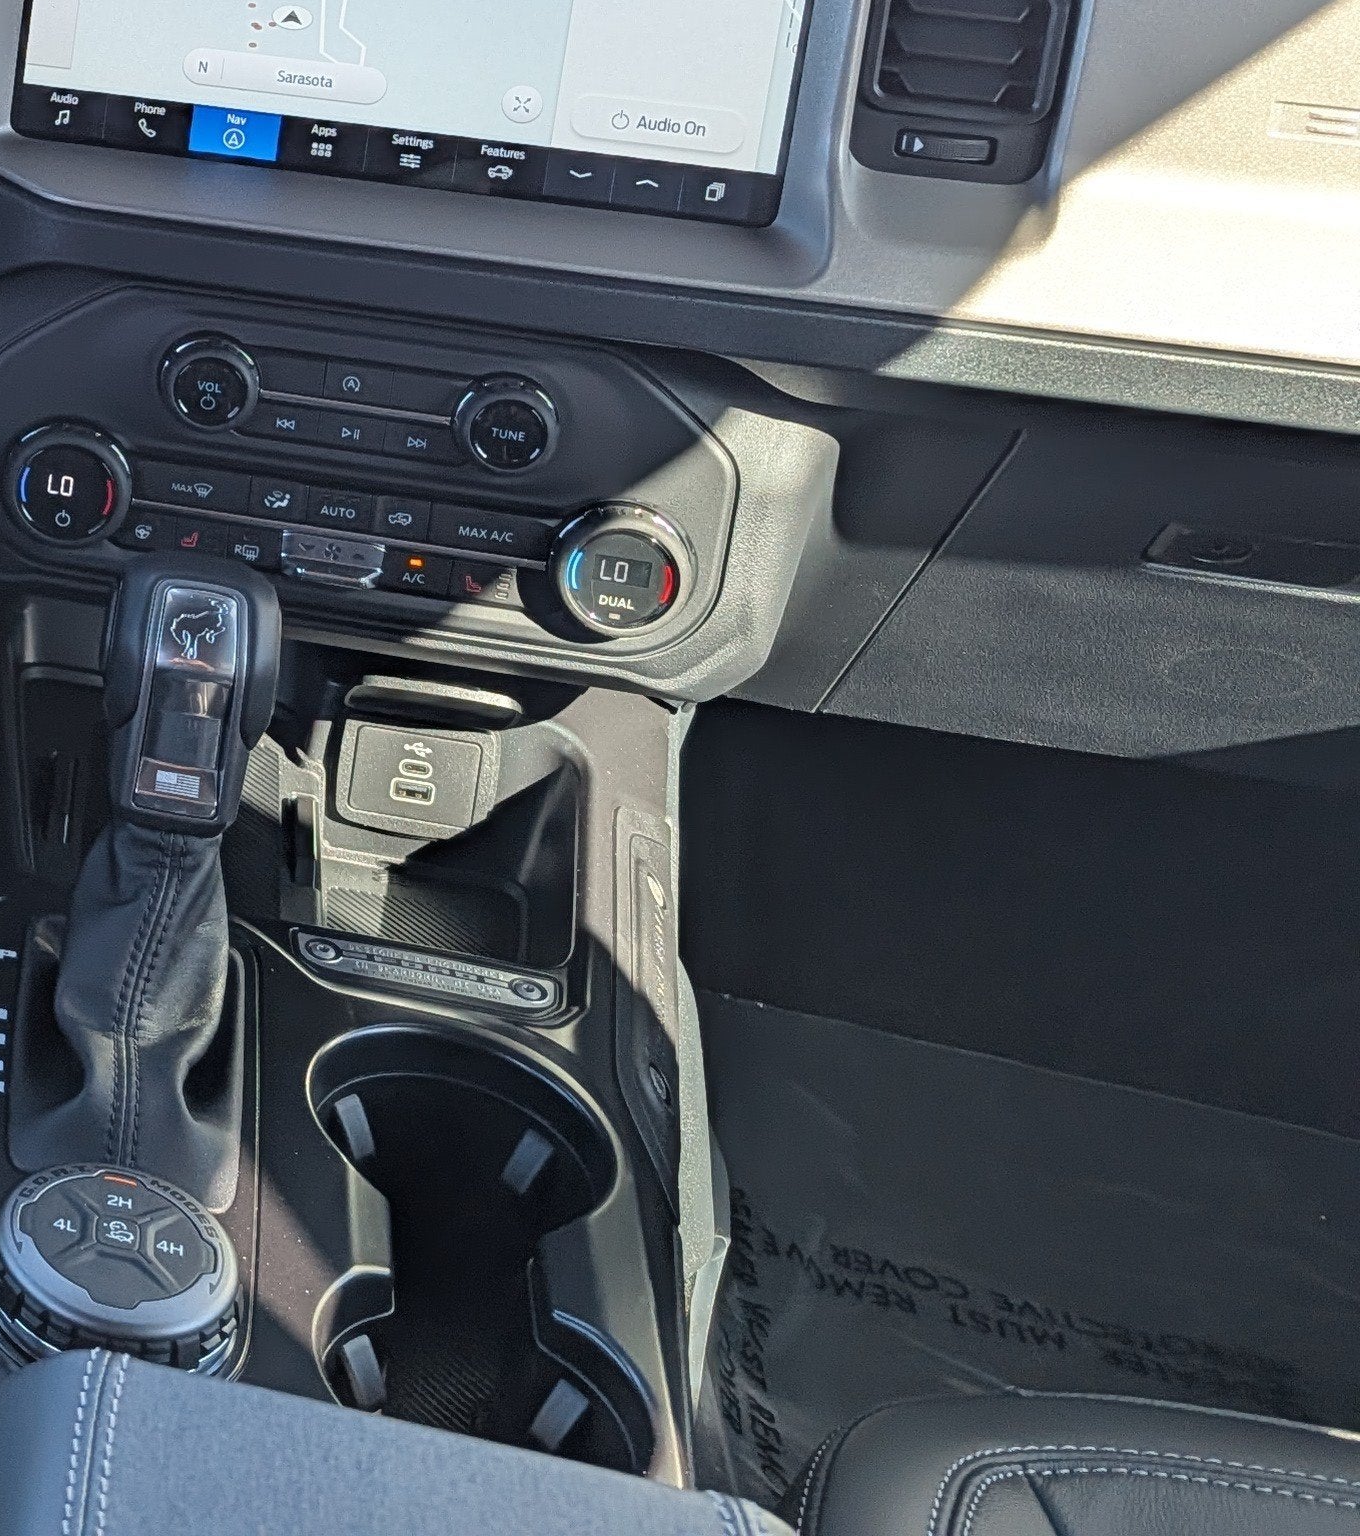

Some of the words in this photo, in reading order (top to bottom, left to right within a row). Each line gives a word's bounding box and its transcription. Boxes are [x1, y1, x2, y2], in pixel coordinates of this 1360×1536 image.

[198, 60, 208, 73] N
[277, 70, 333, 89] Sarasota
[50, 93, 79, 106] Audio
[134, 103, 166, 116] Phone
[226, 114, 247, 126] Nav
[636, 115, 681, 135] Audio
[684, 121, 707, 137] On
[311, 125, 337, 138] Apps
[392, 134, 434, 150] Settings
[481, 145, 526, 161] Features
[197, 380, 222, 394] VOL
[491, 427, 526, 443] TUNE
[171, 482, 193, 494] MAX
[320, 505, 356, 520] AUTO
[458, 525, 487, 541] MAX
[488, 529, 514, 544] A/C
[402, 571, 425, 585] A/C
[598, 595, 635, 611] DUAL
[107, 1194, 132, 1210] 2H
[150, 1179, 220, 1240] MODES
[53, 1217, 77, 1233] 4L
[156, 1240, 184, 1256] 4H
